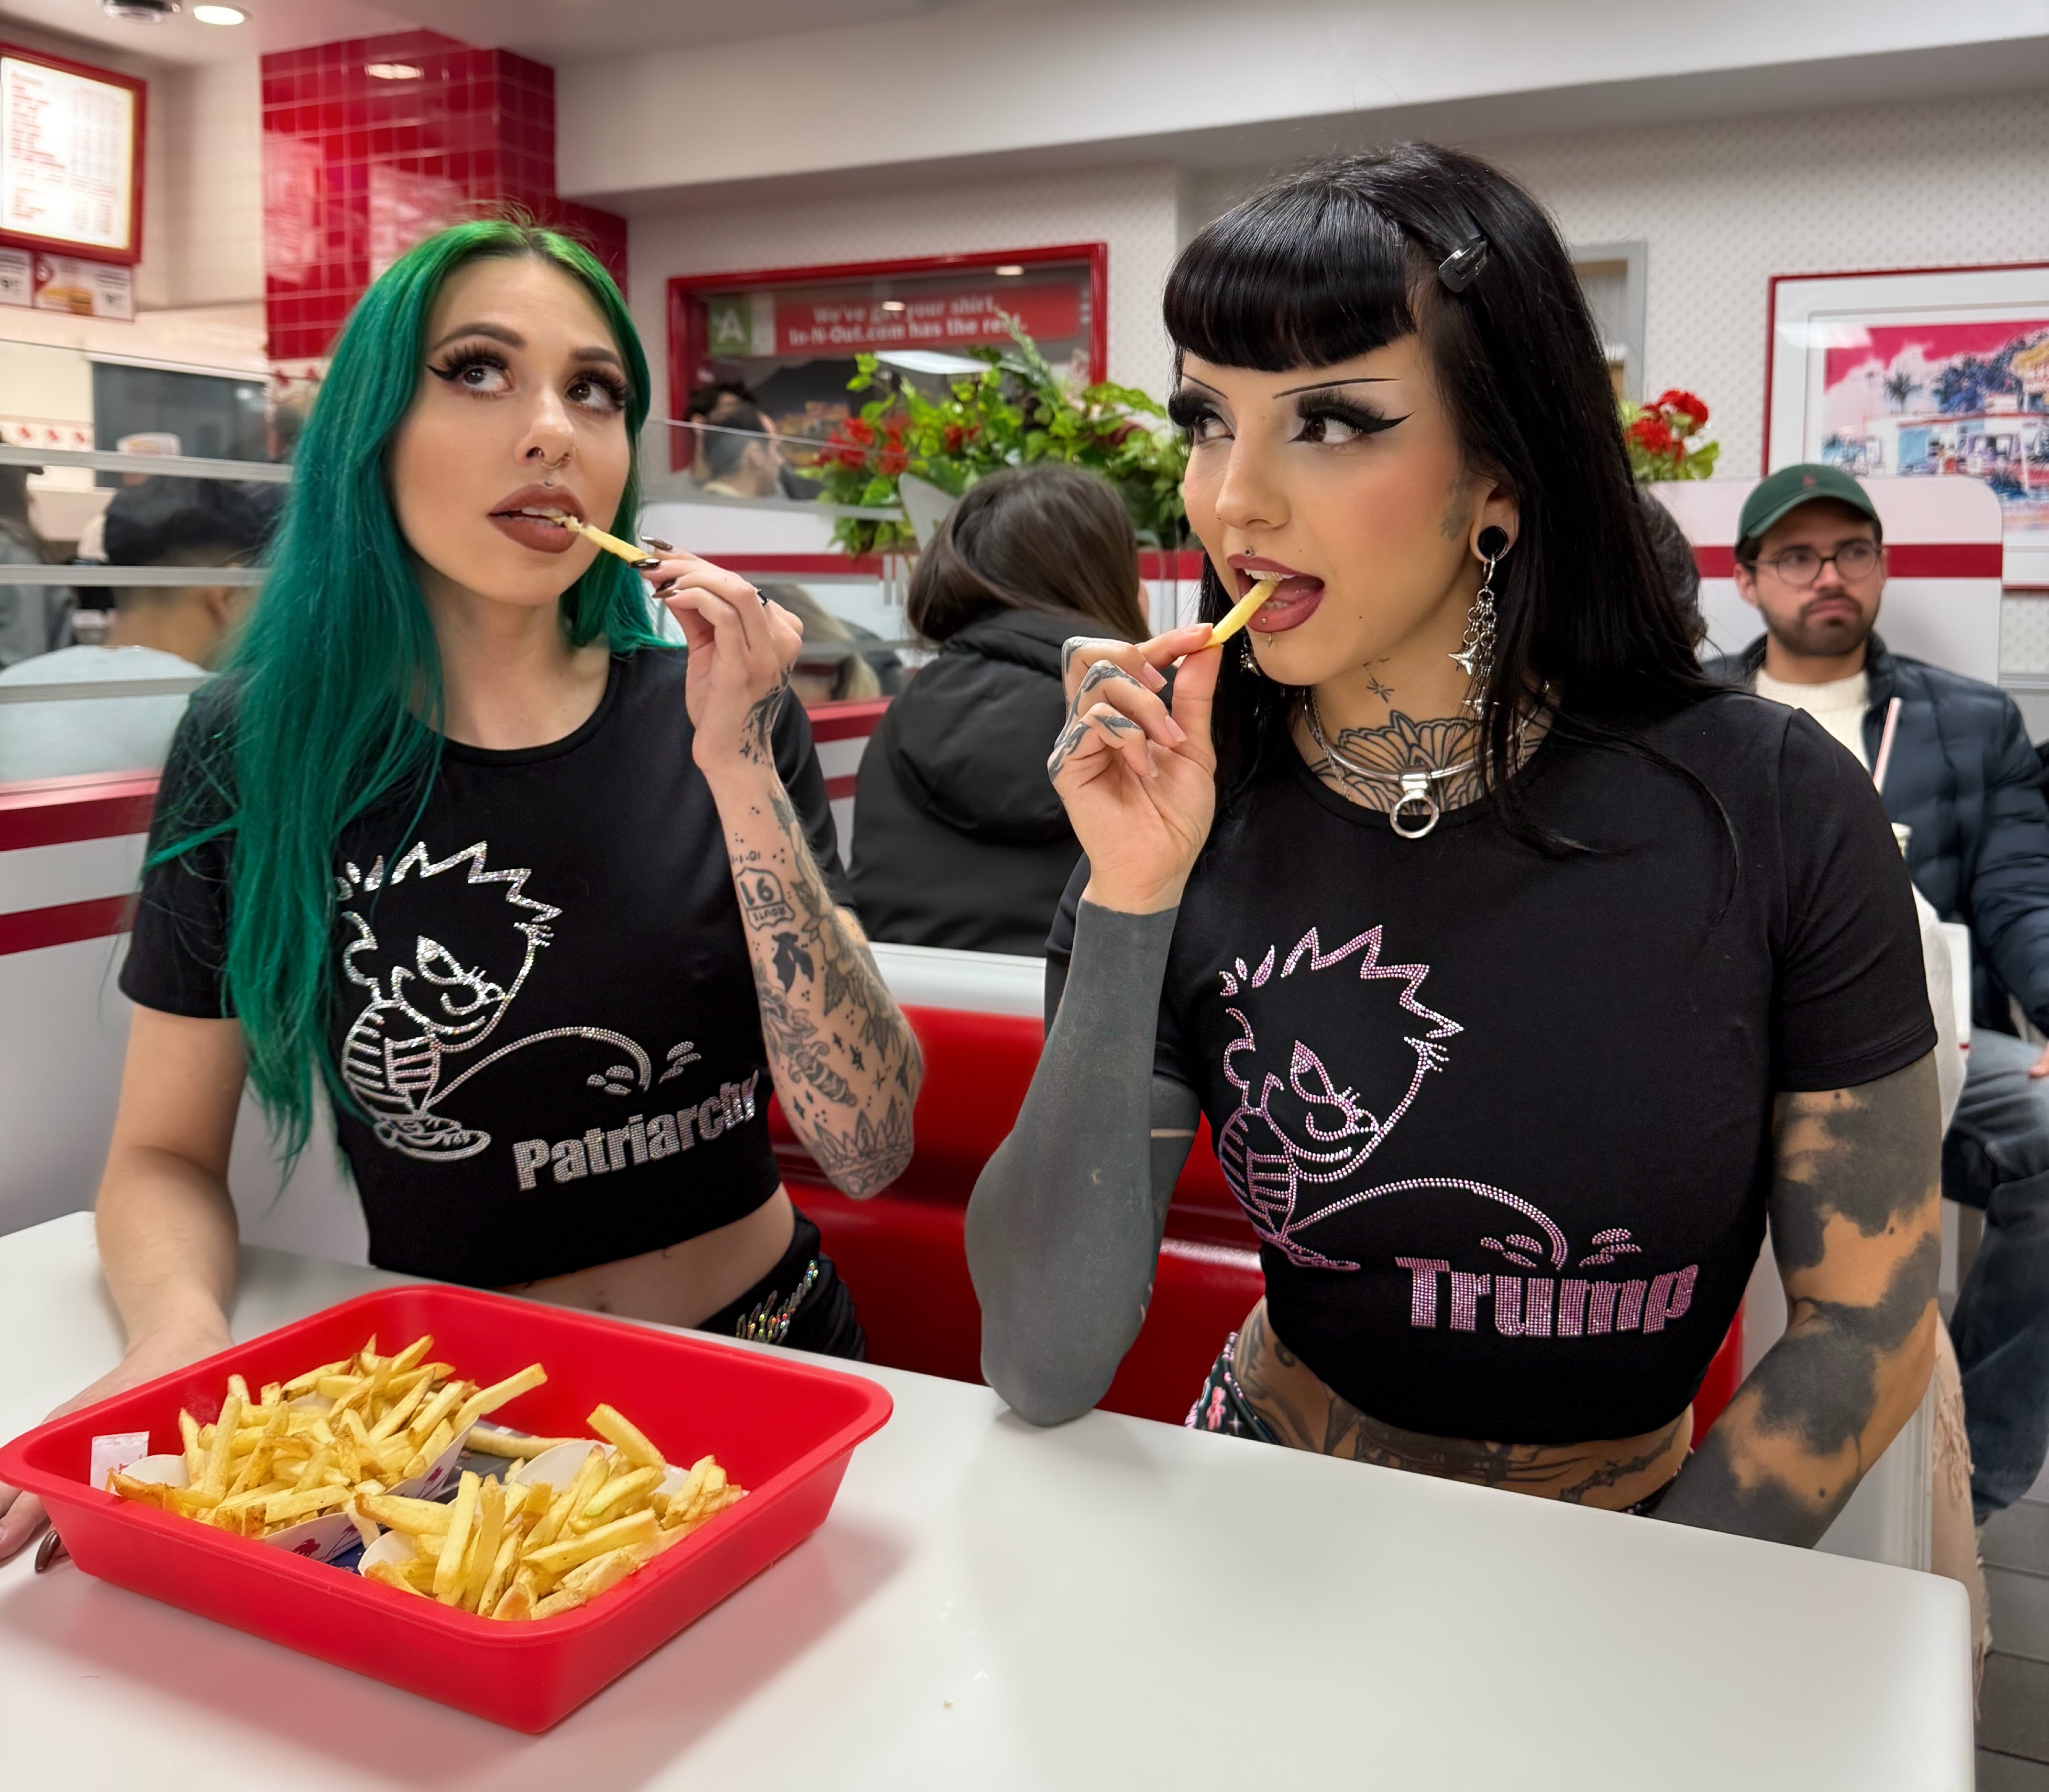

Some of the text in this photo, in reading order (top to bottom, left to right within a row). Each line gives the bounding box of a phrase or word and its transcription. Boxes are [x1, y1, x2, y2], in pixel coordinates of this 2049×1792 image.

[718, 308, 746, 344] A
[905, 300, 945, 322] your
[789, 320, 905, 347] In-N-Out.com
[908, 318, 941, 339] has
[947, 315, 979, 336] the
[513, 1069, 759, 1191] Patriarchy
[1395, 1256, 1698, 1337] Trump
